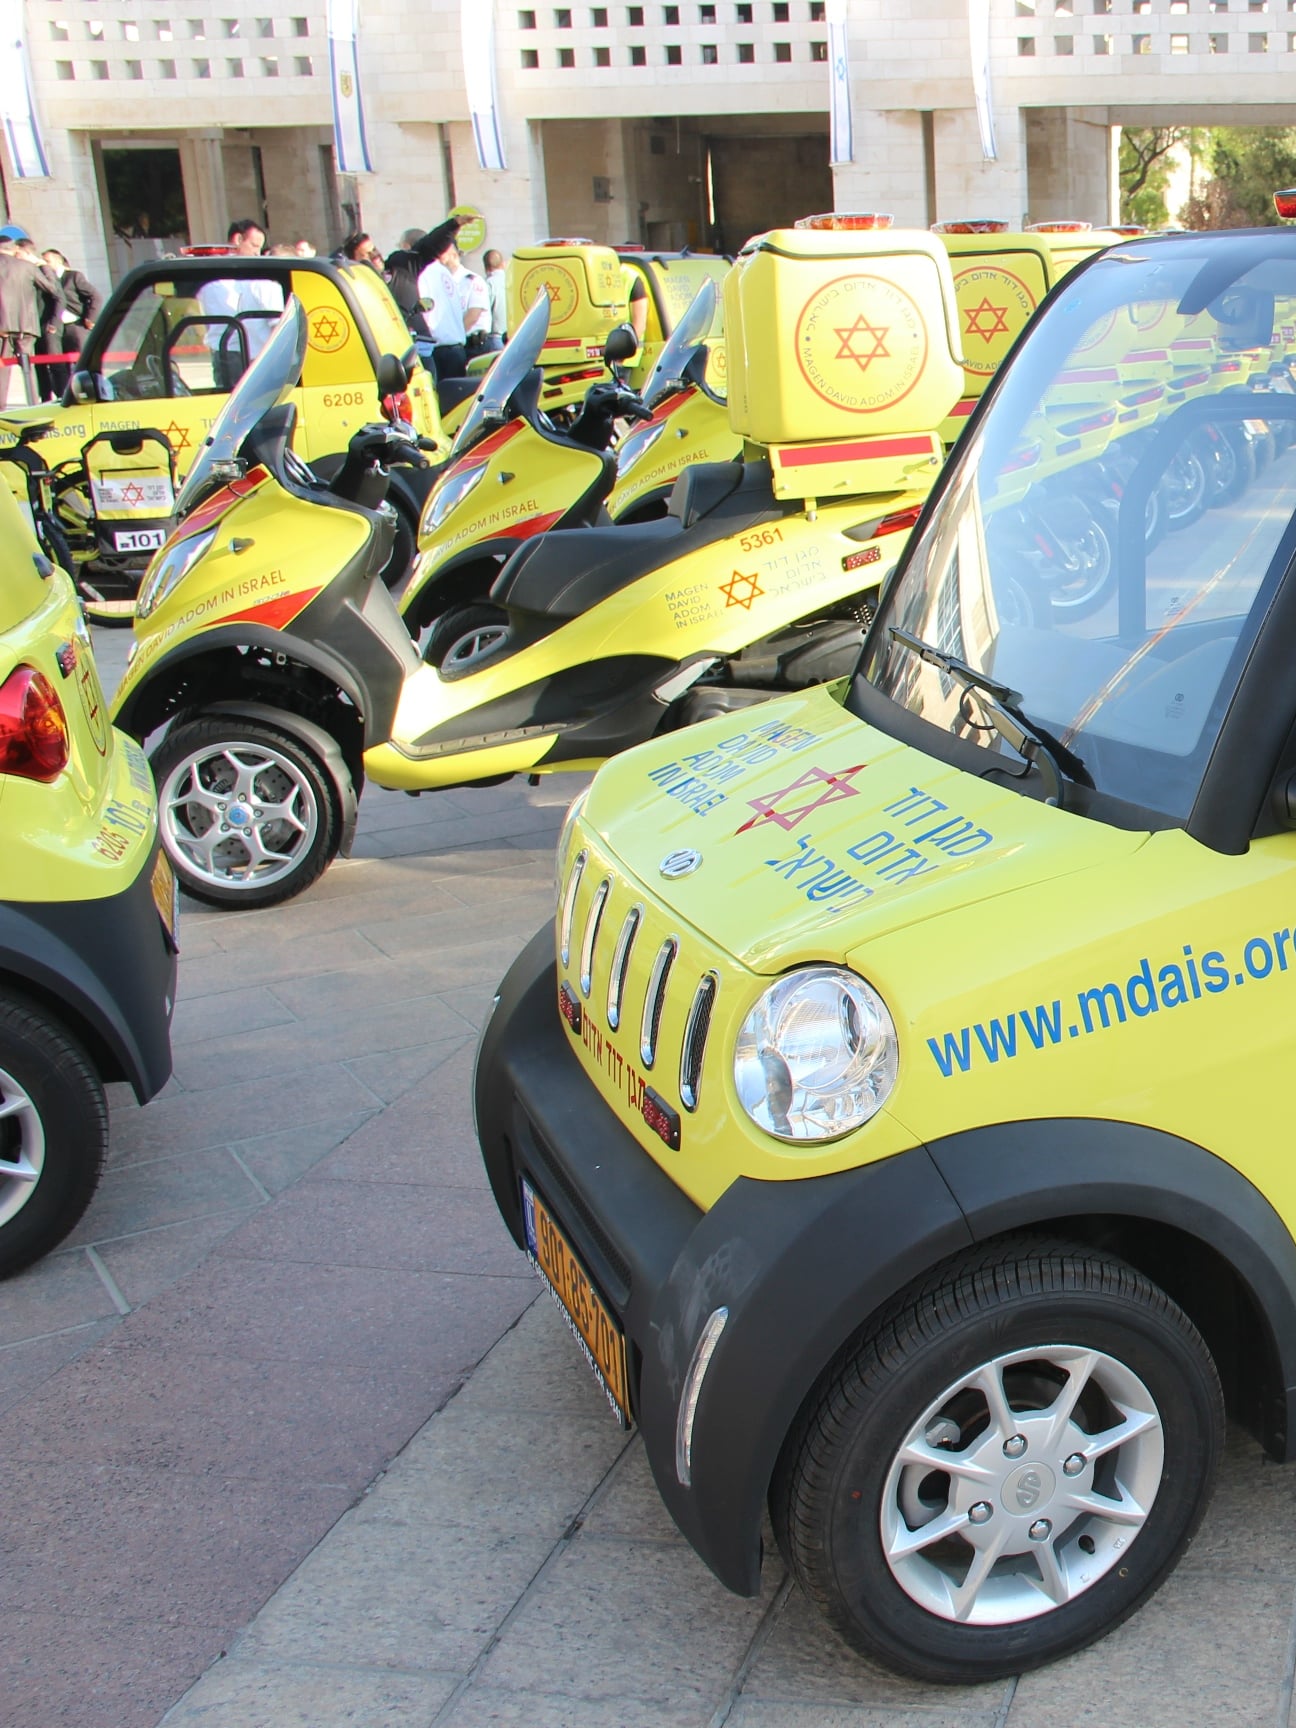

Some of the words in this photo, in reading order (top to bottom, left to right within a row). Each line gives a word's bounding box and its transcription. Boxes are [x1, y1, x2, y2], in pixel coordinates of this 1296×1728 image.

[843, 281, 877, 292] אדום
[971, 271, 997, 280] אדום
[1001, 275, 1018, 290] דוד
[805, 289, 840, 332] בישראל
[803, 347, 826, 389] MAGEN
[825, 386, 858, 406] DAVID
[860, 388, 895, 407] ADOM
[895, 381, 905, 392] IN
[323, 392, 364, 407] 6208
[100, 420, 140, 430] MAGEN
[640, 466, 666, 487] ADOM
[668, 461, 677, 470] IN
[679, 449, 709, 465] ISRAEL
[455, 519, 487, 540] ADOM
[489, 512, 500, 524] IN
[502, 499, 539, 519] ISRAEL
[128, 533, 161, 548] 101
[740, 527, 784, 552] 5361
[763, 555, 789, 571] דוד
[177, 596, 218, 631] ADOM
[222, 588, 235, 603] IN
[238, 570, 286, 596] ISRAEL
[665, 583, 709, 602] MAGEN
[668, 596, 702, 612] DAVID
[673, 603, 711, 621] ADOM
[676, 620, 688, 629] IN
[717, 733, 778, 765] DAVID
[750, 719, 822, 752] MAGEN
[647, 762, 688, 787] IN
[681, 750, 746, 785] ADOM
[666, 777, 729, 818] ISRAEL
[882, 787, 948, 827] דוד
[912, 815, 994, 857] מגן
[763, 834, 874, 913] בישראל
[846, 831, 940, 885] אדום
[583, 1008, 603, 1067] אדום
[605, 1040, 623, 1089] דוד
